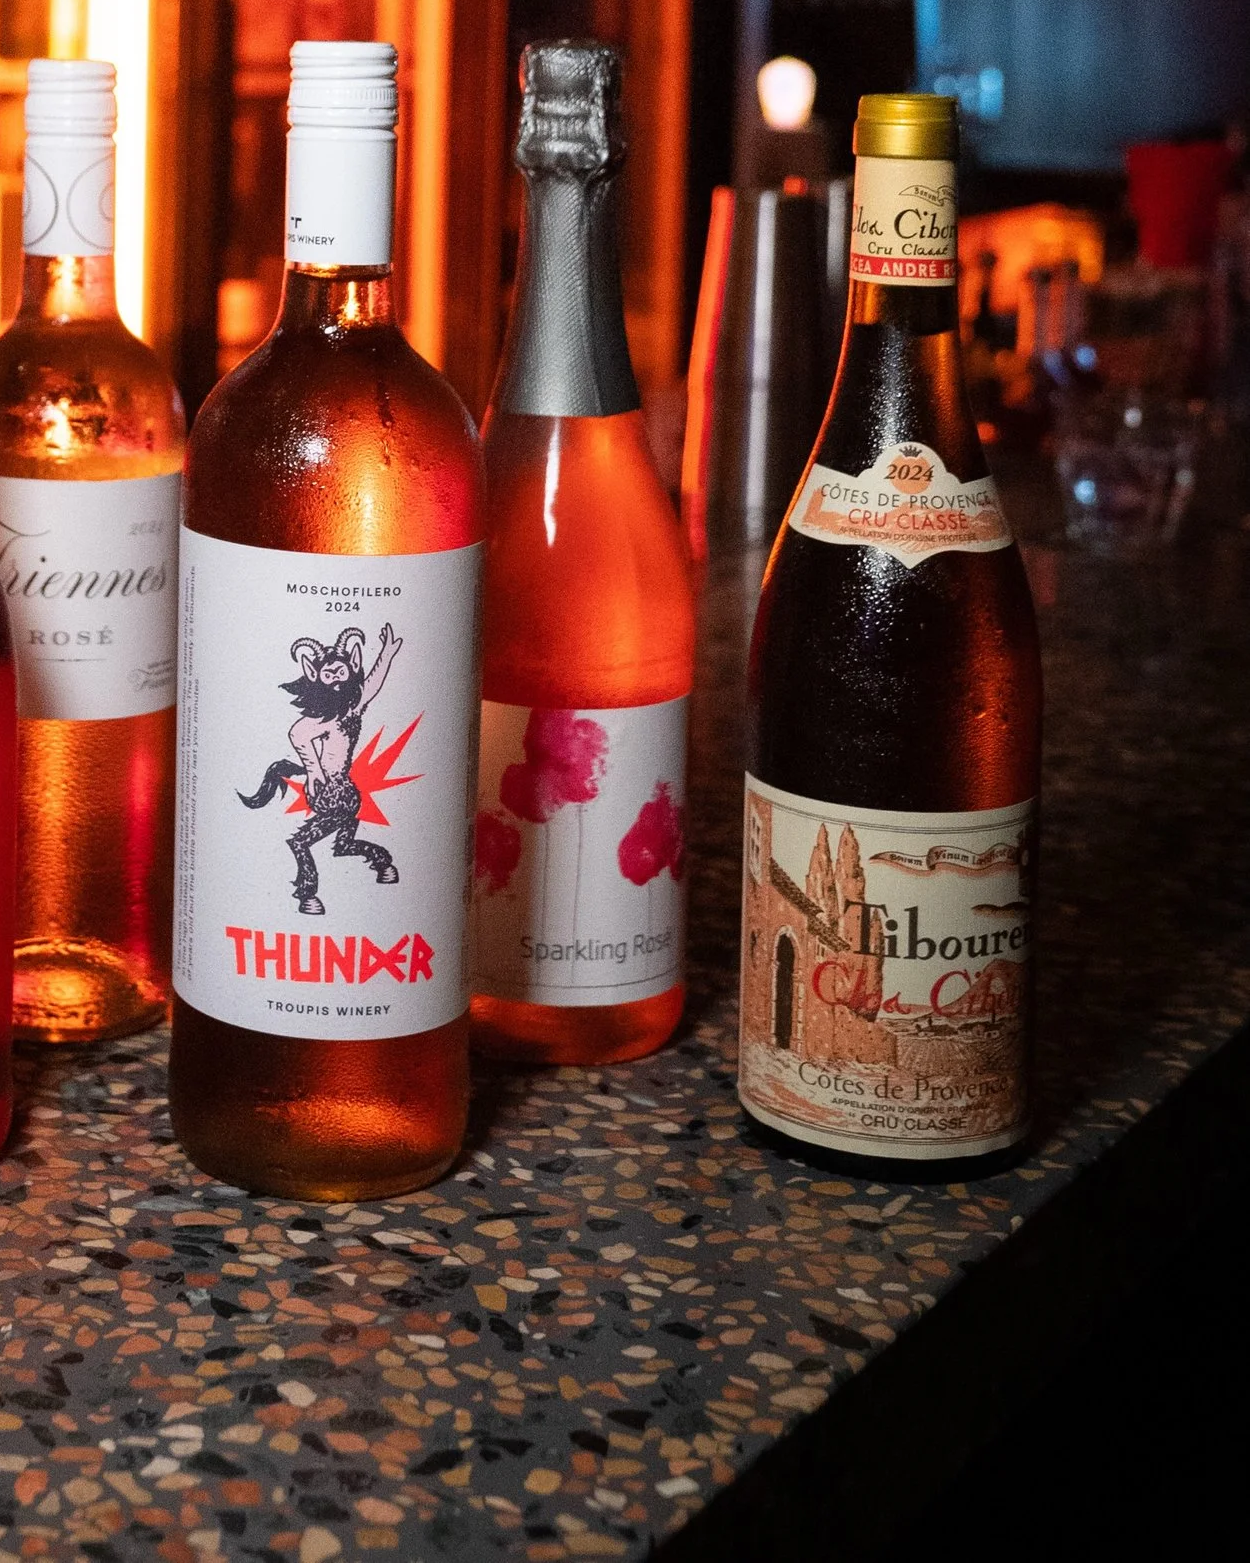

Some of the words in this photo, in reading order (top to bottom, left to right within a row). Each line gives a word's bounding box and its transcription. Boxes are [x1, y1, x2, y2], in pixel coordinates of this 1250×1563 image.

[297, 234, 335, 245] WINERY
[867, 241, 893, 255] Cru
[880, 260, 937, 278] ANDRÉ
[883, 463, 936, 483] 2024
[819, 483, 870, 506] CÔTES
[877, 492, 901, 508] DE
[909, 489, 992, 510] PROVENCE
[847, 508, 888, 528] CRU
[896, 510, 970, 531] CLASSÉ
[286, 582, 403, 598] MOSCHOFILERO
[325, 600, 362, 613] 2024
[28, 625, 115, 646] ROSÉ
[225, 925, 436, 985] THUNDER
[519, 936, 627, 964] Sparkling
[267, 999, 330, 1016] TROUPIS
[336, 1004, 392, 1017] WINERY
[874, 1075, 905, 1100] de
[913, 1076, 1010, 1101] Provence
[831, 1097, 896, 1113] APPELLATION
[861, 1113, 899, 1130] CRU
